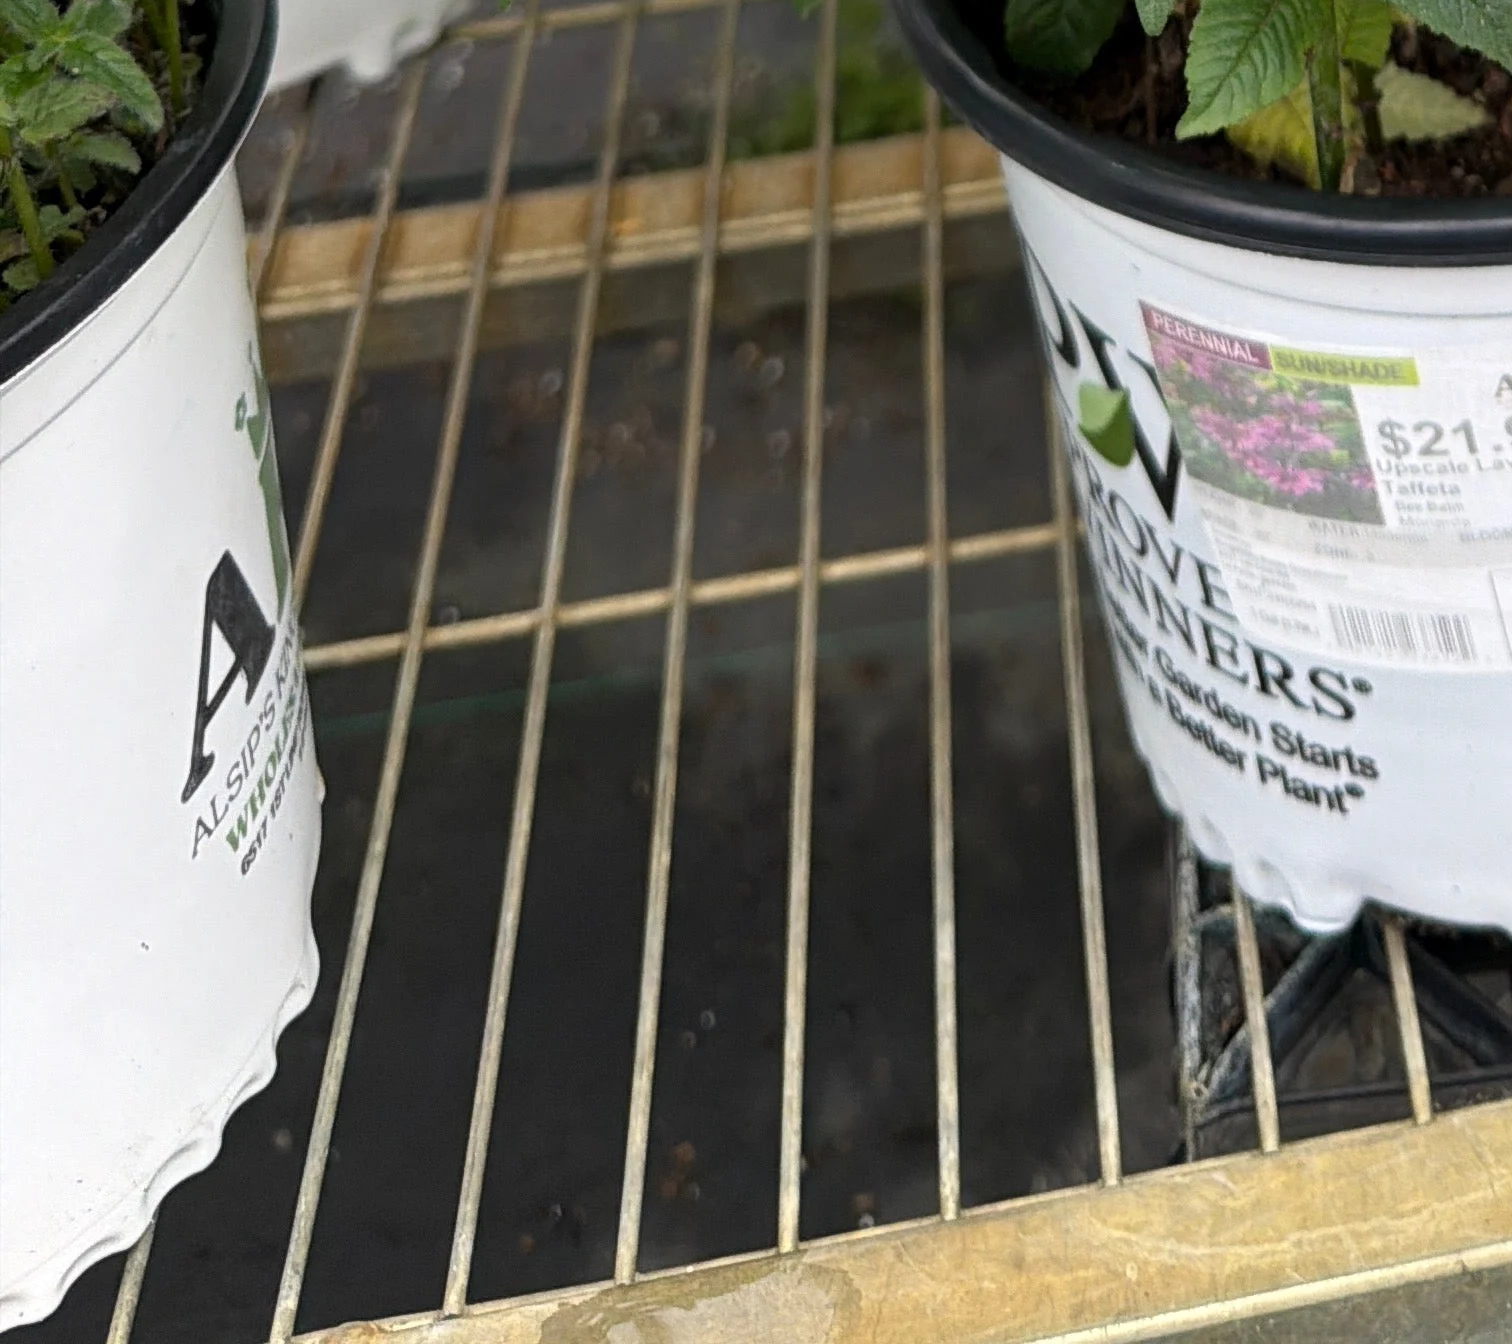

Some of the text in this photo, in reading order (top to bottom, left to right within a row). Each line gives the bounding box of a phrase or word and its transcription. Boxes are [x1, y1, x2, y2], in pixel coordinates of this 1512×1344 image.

[1151, 311, 1260, 363] PERENNIAL
[1274, 350, 1408, 381] SUN/SHADE
[1375, 458, 1470, 477] Upscale
[1382, 479, 1462, 497] Taffeta
[1064, 424, 1242, 626] PROVE
[180, 550, 276, 805] A
[1153, 645, 1263, 743] Garden
[1268, 719, 1381, 780] Starts
[1164, 690, 1247, 773] Better
[191, 690, 277, 860] ALSIP'S
